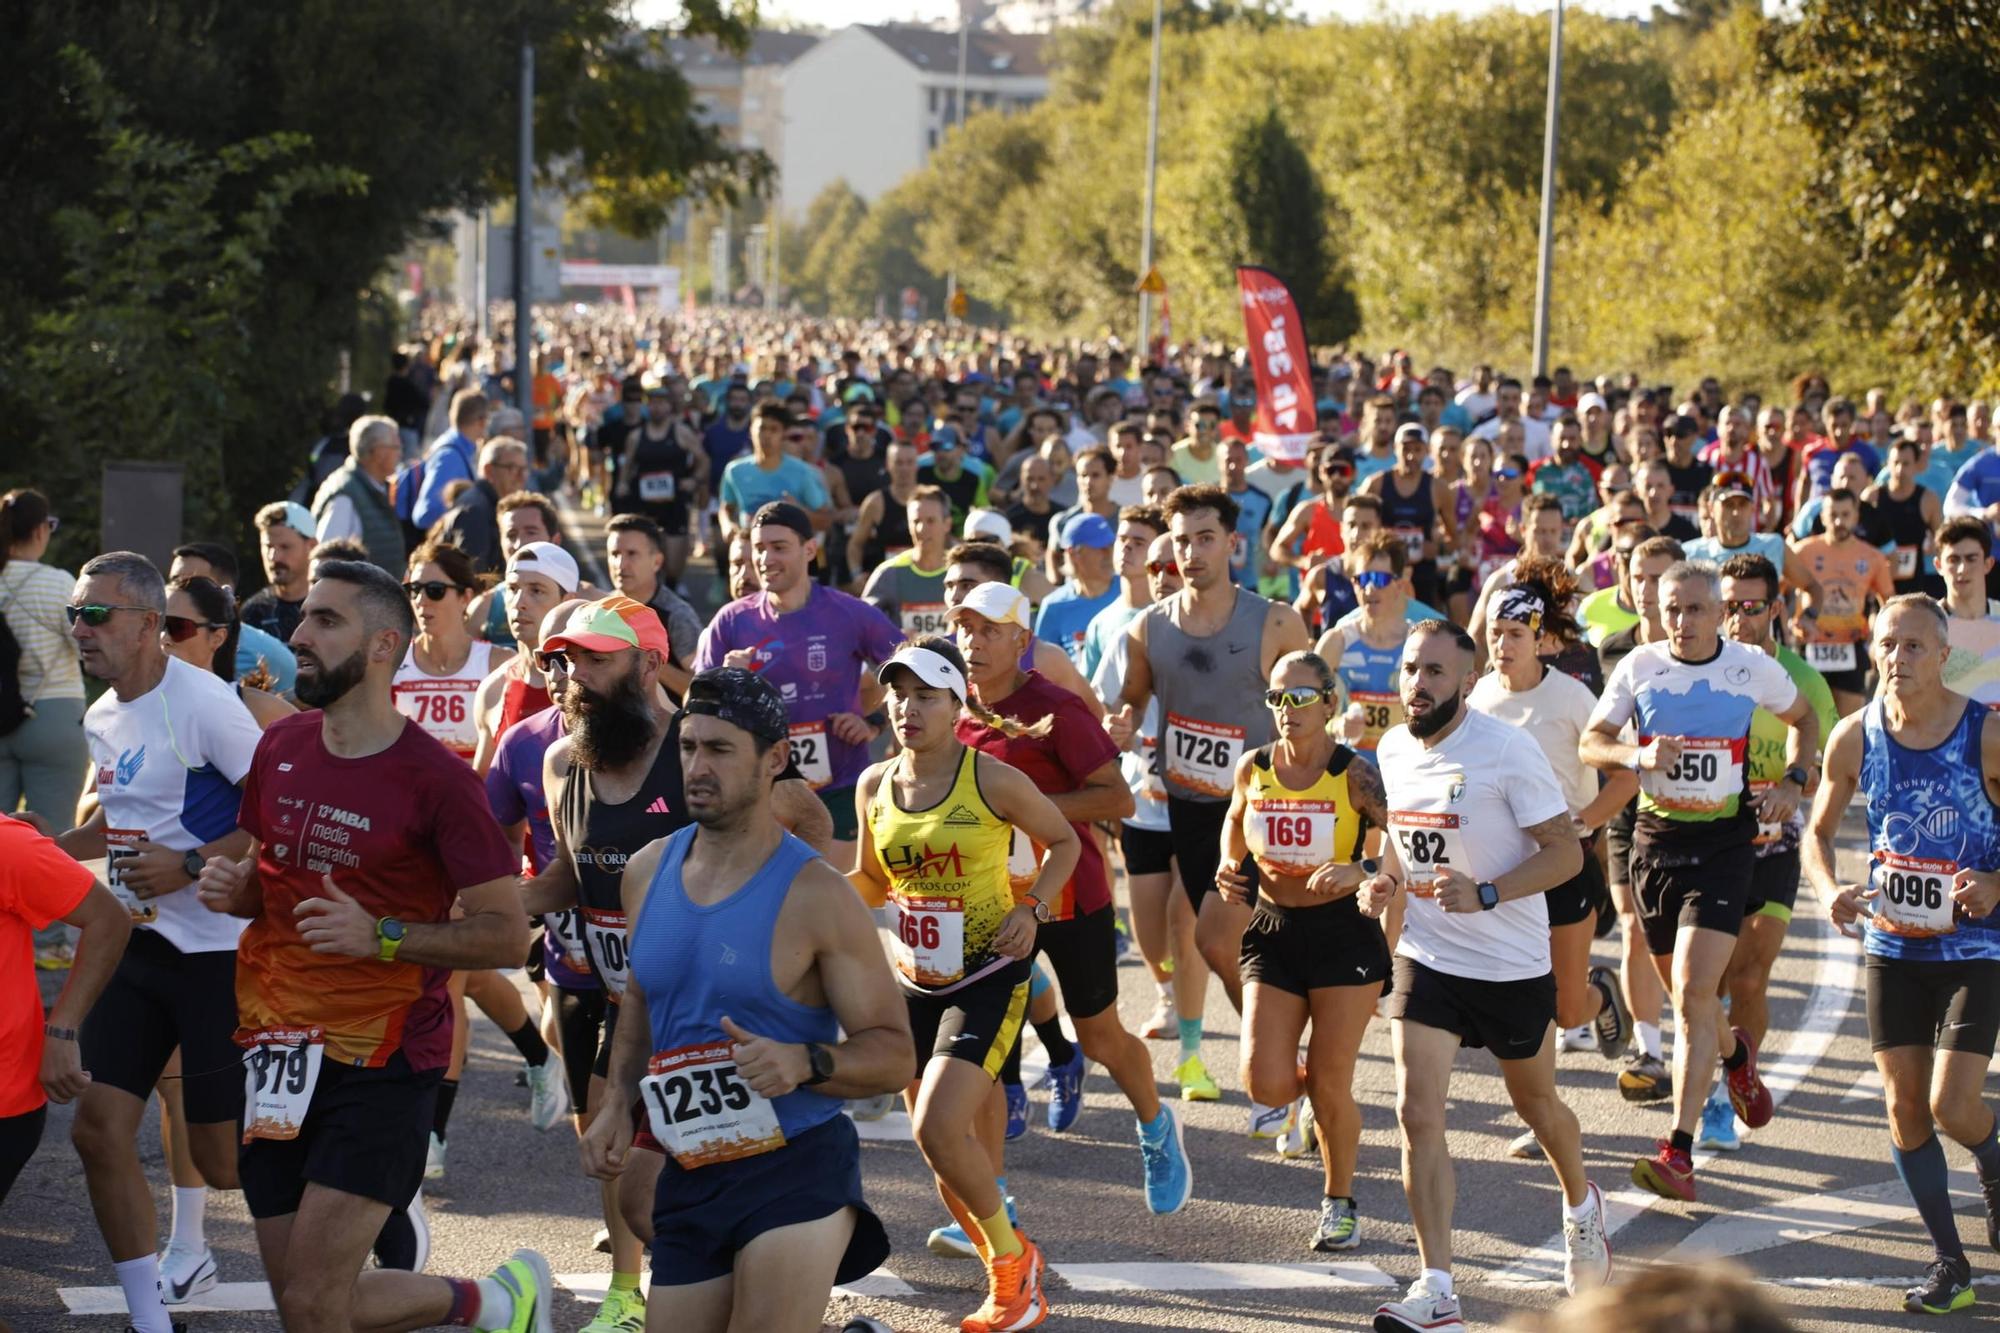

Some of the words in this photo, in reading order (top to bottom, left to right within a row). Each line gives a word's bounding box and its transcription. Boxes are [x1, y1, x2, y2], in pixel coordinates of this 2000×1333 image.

[414, 694, 465, 723] 786
[1174, 730, 1231, 768] 1726
[1895, 778, 1953, 798] RUNNERS
[310, 823, 350, 845] media
[330, 808, 371, 832] MBA
[1265, 815, 1312, 847] 169
[307, 841, 360, 869] maratón
[1398, 830, 1450, 863] 582
[898, 910, 940, 950] 166
[649, 1066, 751, 1125] 1235
